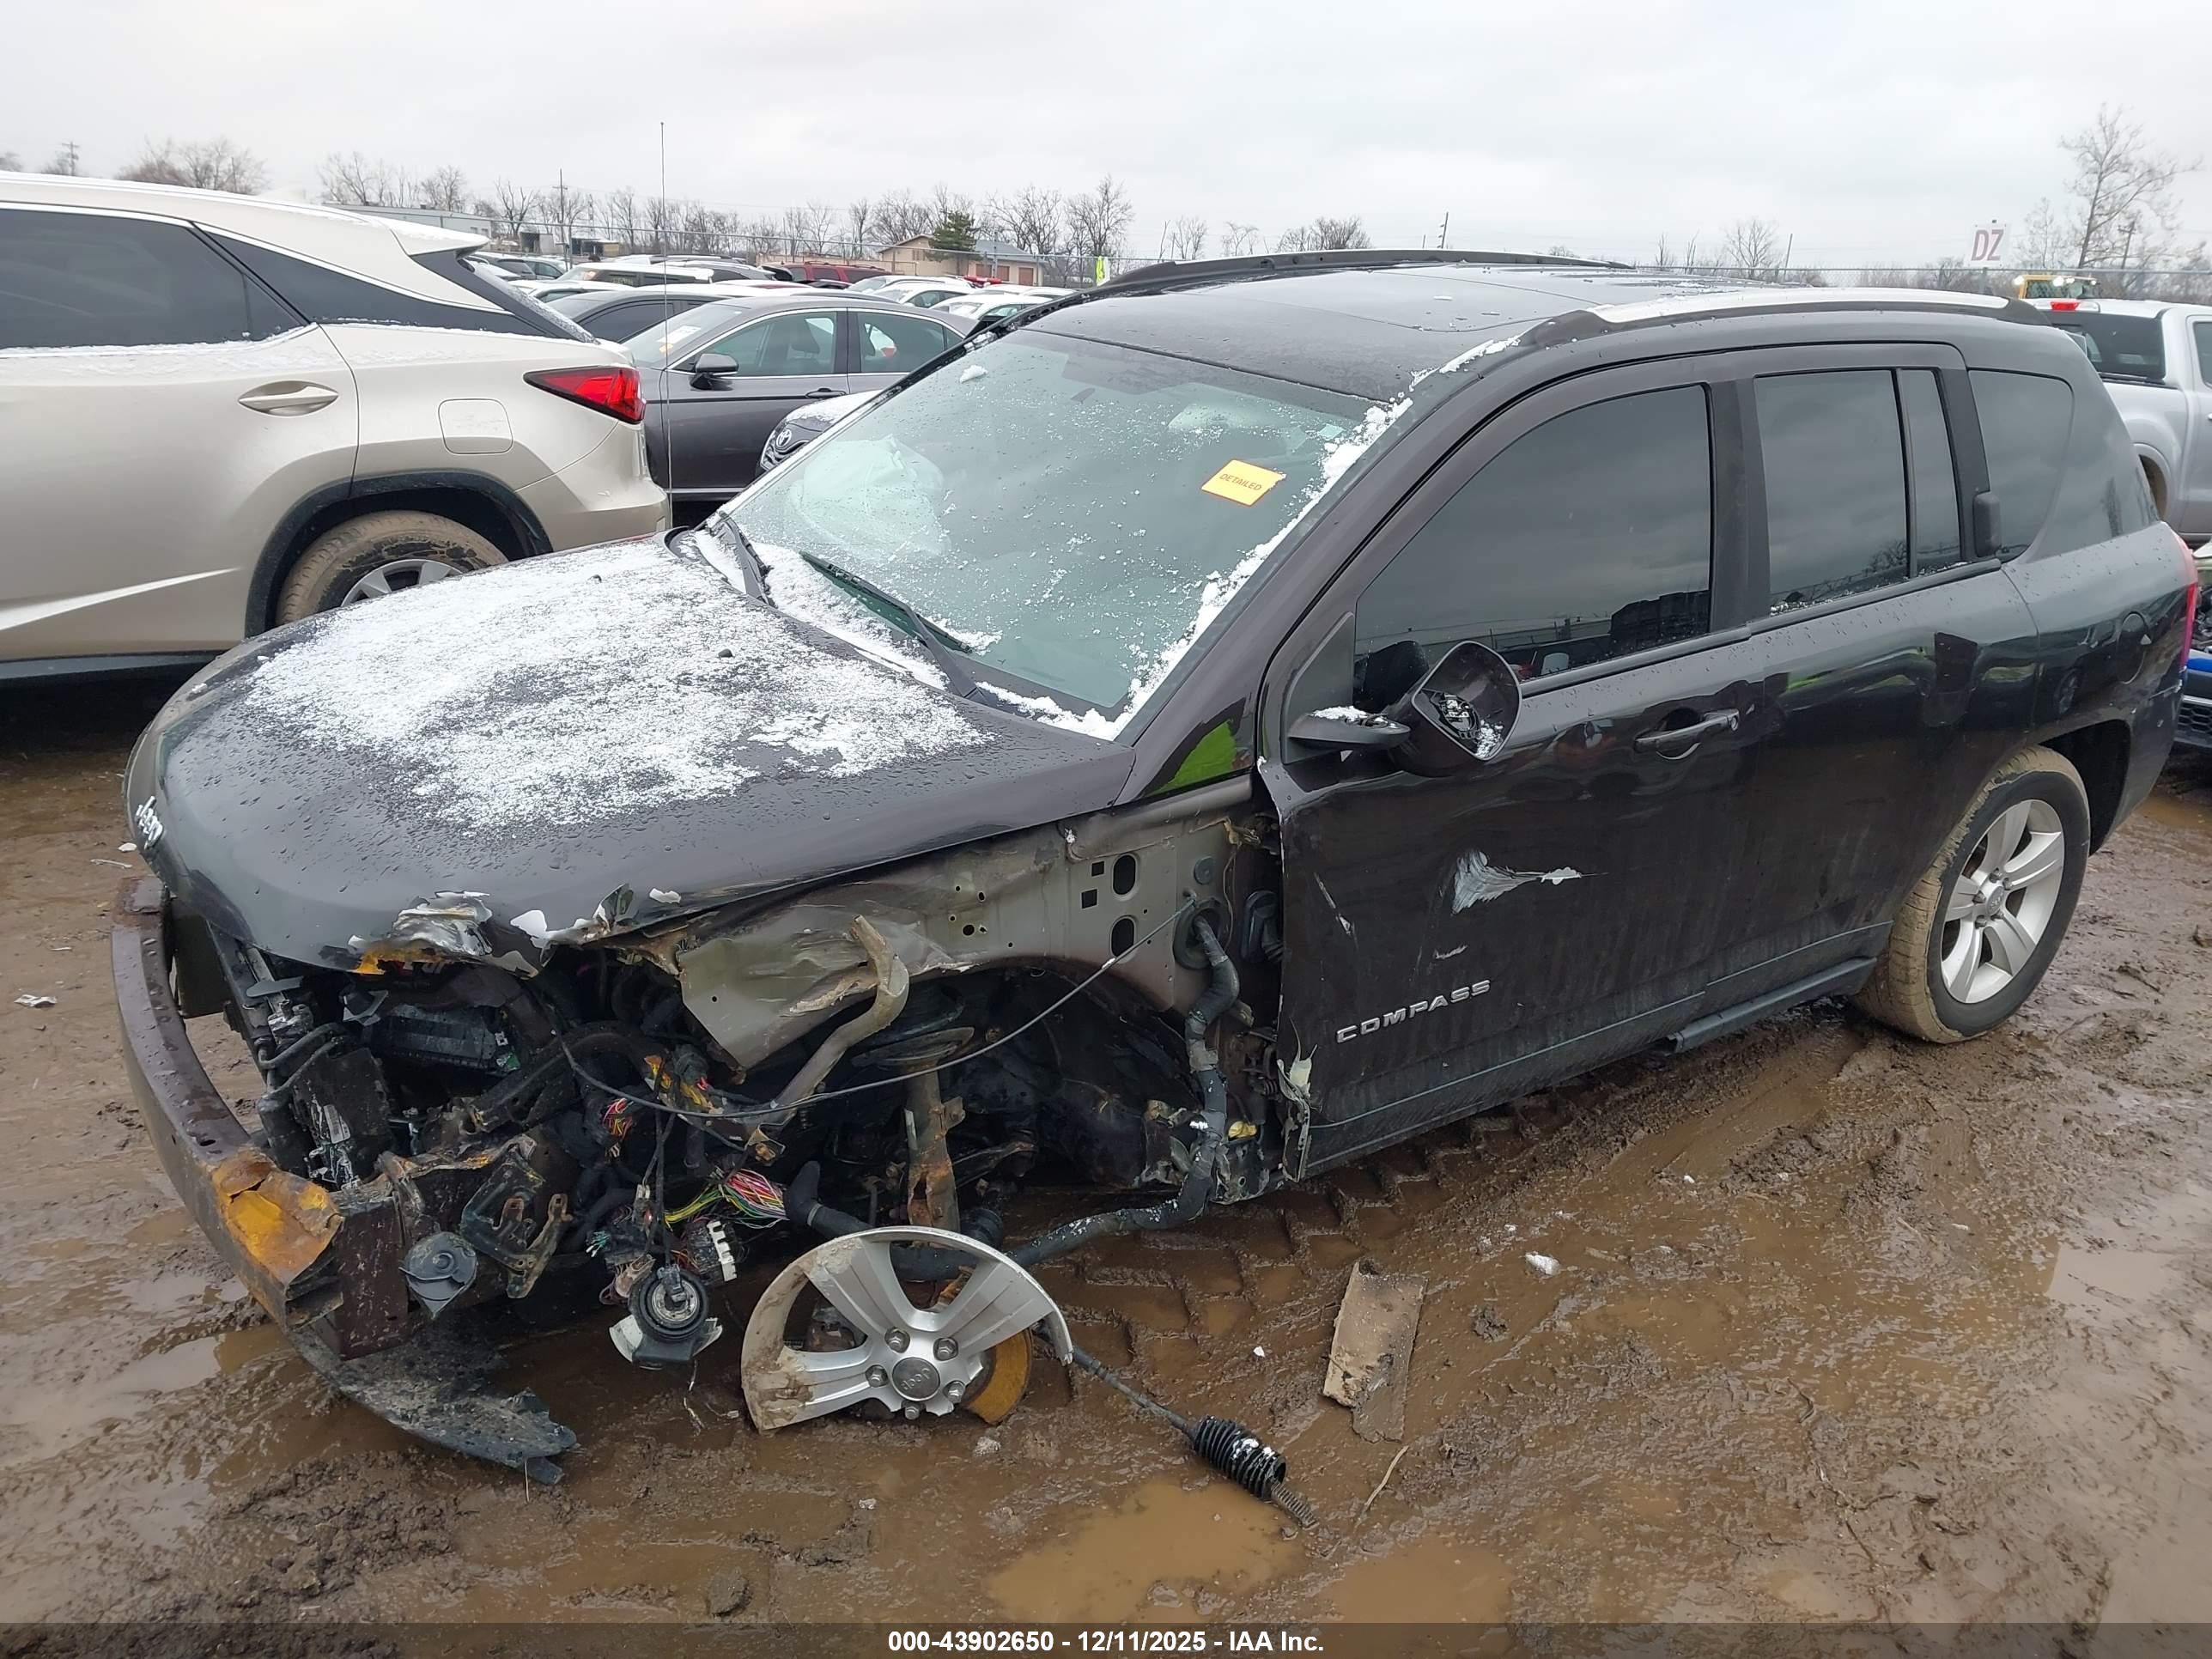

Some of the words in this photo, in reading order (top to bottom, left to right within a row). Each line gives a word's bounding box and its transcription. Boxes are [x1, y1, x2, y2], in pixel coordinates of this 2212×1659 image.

[1971, 228, 2004, 261] DZ
[1219, 473, 1262, 491] DETAILED
[136, 795, 162, 849] Jeep
[1337, 979, 1491, 1043] COMPASS
